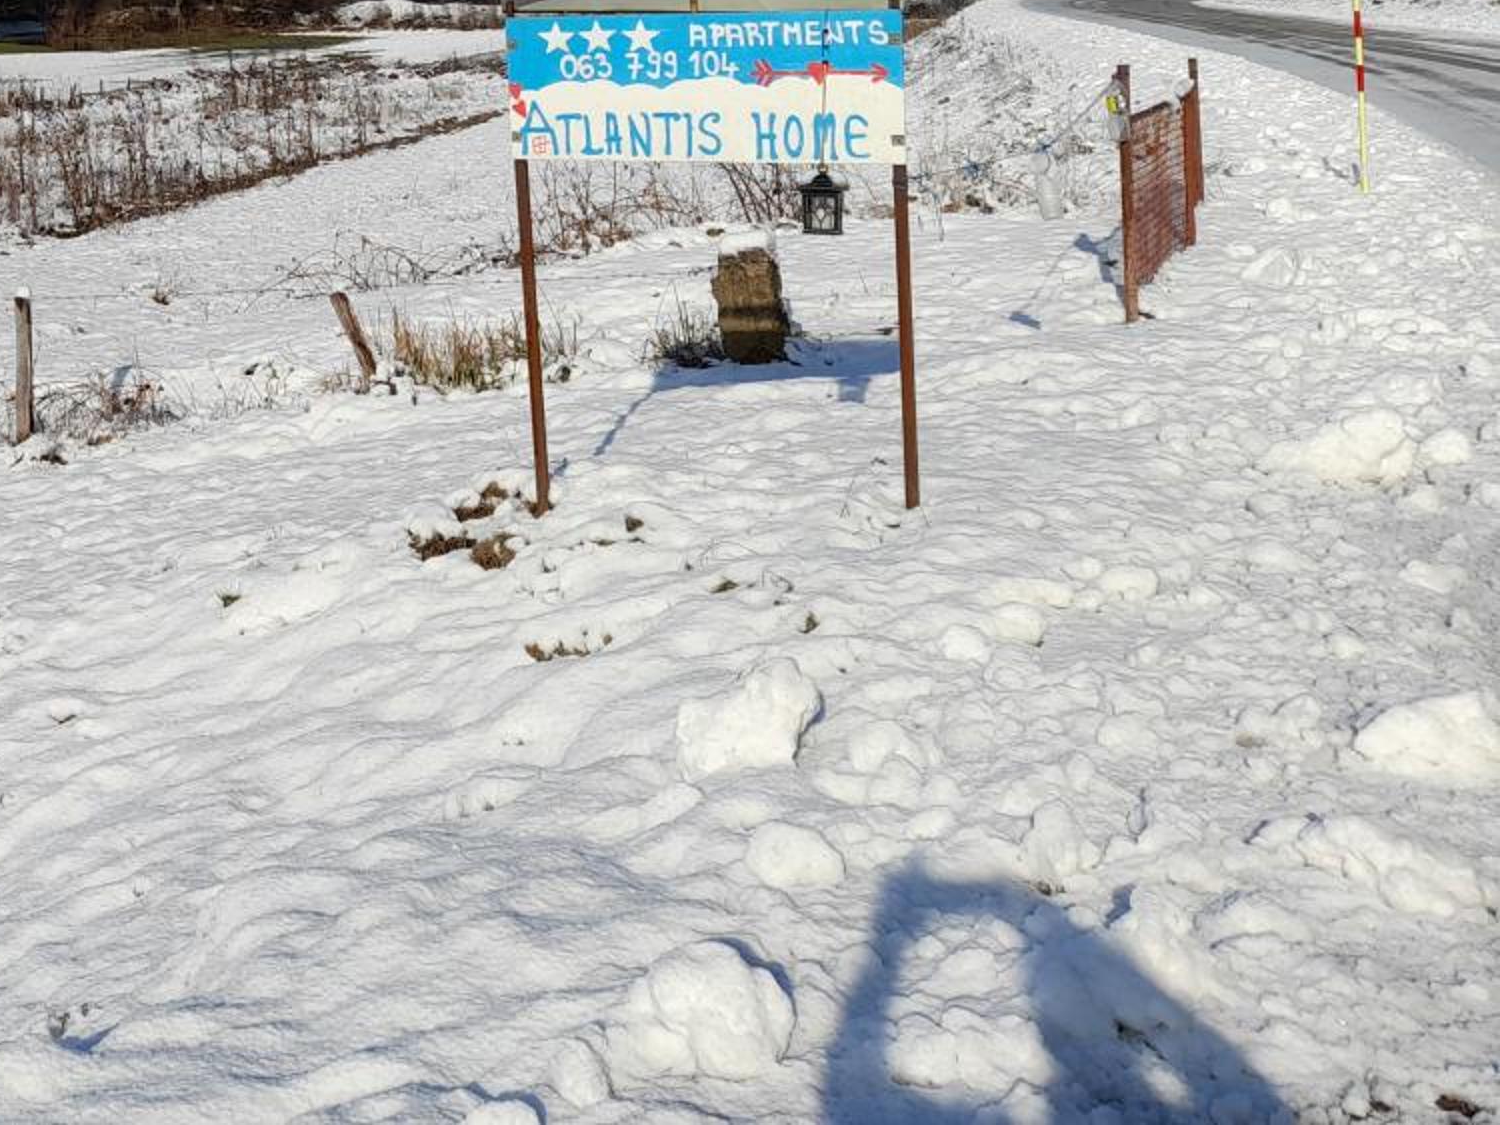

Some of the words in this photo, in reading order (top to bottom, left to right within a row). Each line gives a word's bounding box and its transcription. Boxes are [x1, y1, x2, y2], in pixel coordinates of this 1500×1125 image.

[689, 20, 889, 47] APARTMENTS
[559, 53, 613, 79] 063
[625, 51, 677, 79] 799
[689, 51, 739, 76] 104
[520, 100, 722, 156] ATLANTIS
[752, 112, 871, 160] HOME
